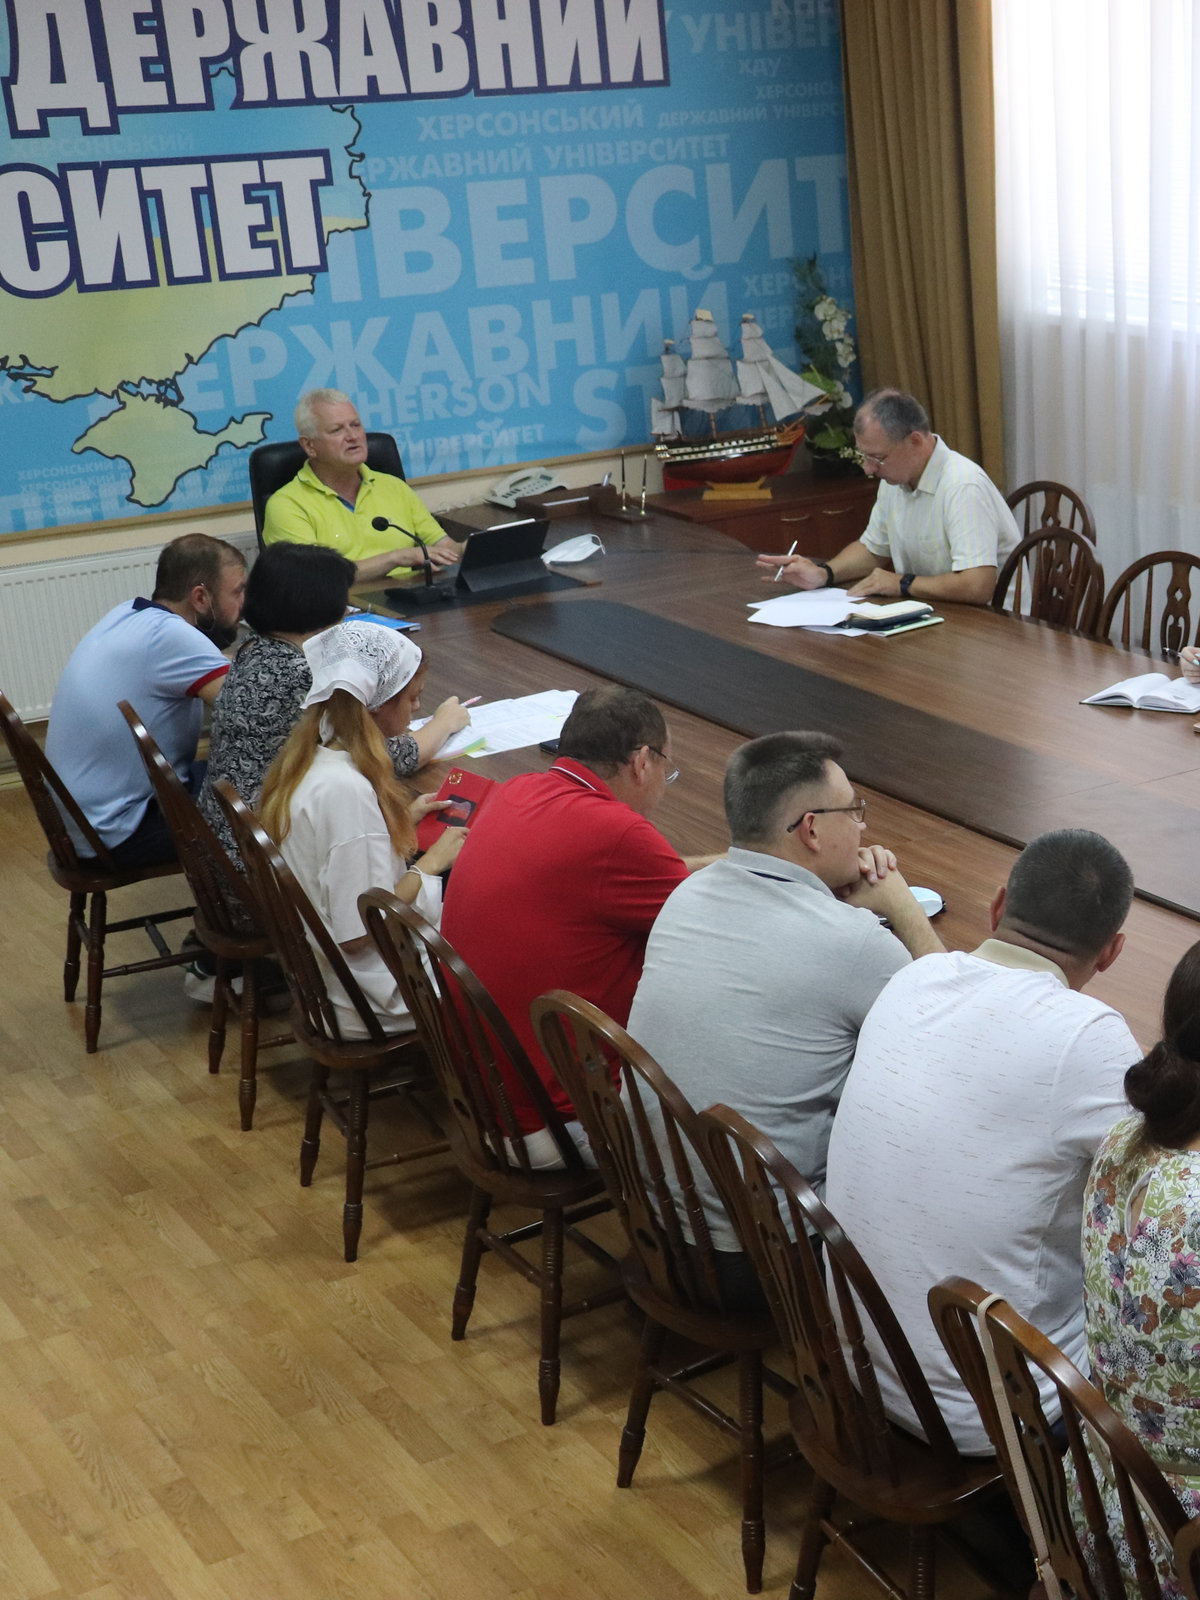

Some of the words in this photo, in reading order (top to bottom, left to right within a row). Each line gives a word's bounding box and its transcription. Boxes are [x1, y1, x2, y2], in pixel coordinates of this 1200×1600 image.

[417, 97, 643, 142] ХЕРСОНСЬКИЙ
[657, 103, 768, 129] ДЕРЖАВНИЙ
[543, 134, 731, 171] УНІВЕРСИТЕТ
